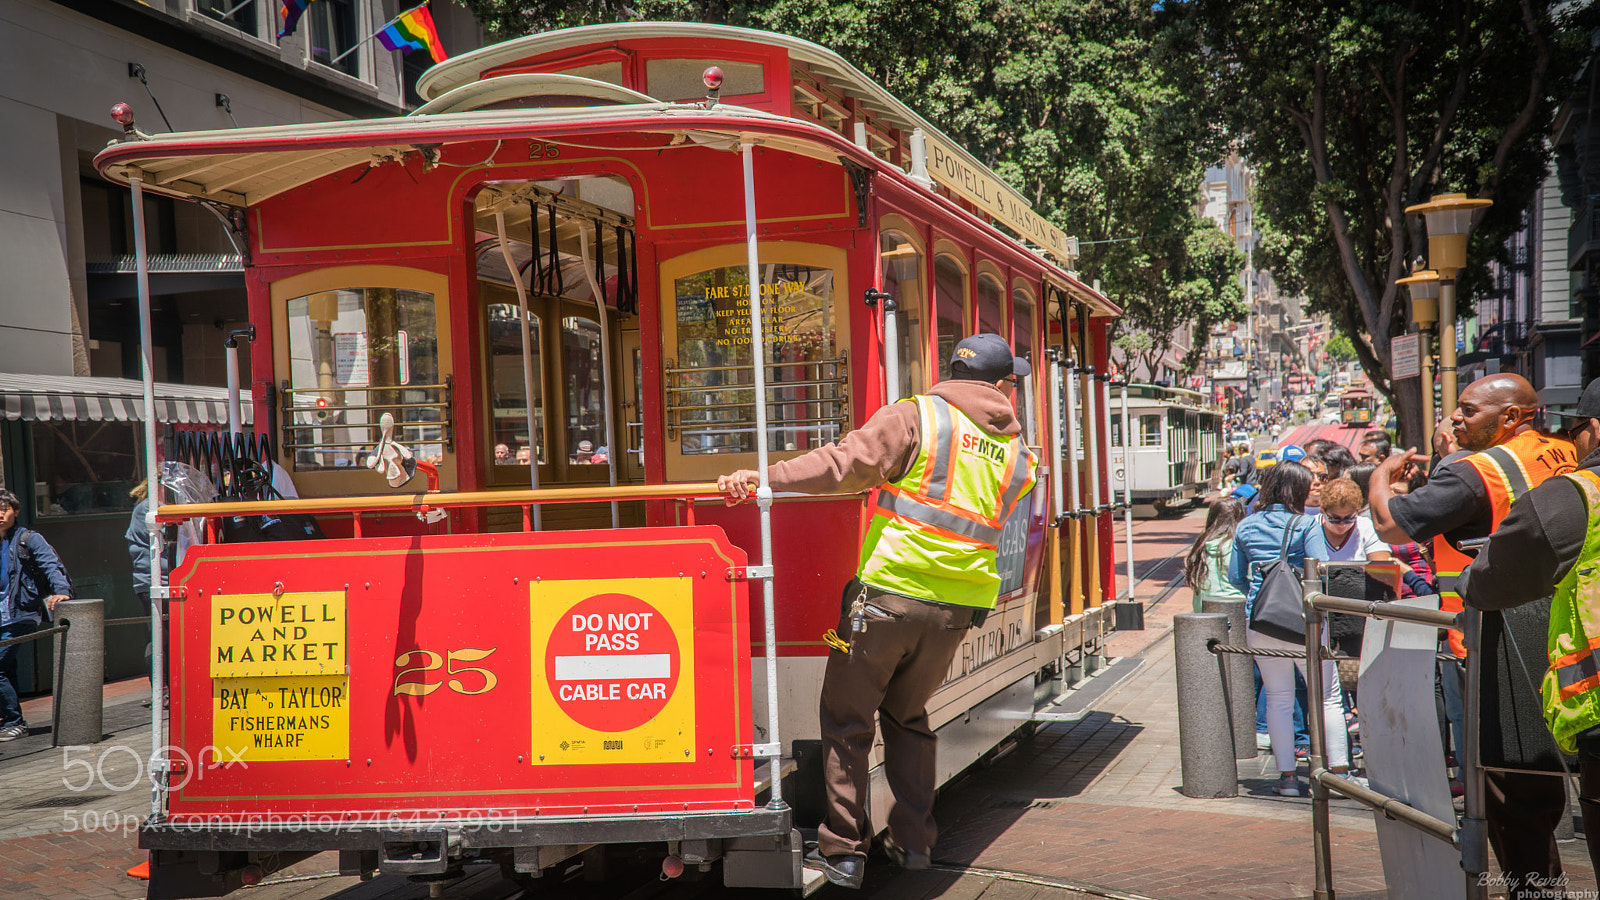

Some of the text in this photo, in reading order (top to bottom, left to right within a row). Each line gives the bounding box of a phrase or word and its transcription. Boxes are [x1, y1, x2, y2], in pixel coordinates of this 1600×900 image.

[529, 142, 560, 160] 25
[933, 145, 991, 204] POWELL
[996, 191, 1005, 214] &
[1009, 200, 1047, 241] MASON
[705, 281, 806, 299] FARE $7.0 ONE WAY
[736, 299, 752, 307] HO
[770, 306, 796, 314] FLOOR
[741, 325, 790, 335] TRSFERS
[733, 337, 753, 345] FOO
[962, 433, 1005, 463] SFMTA
[220, 604, 336, 626] POWELL
[572, 612, 653, 631] DO NOT
[250, 626, 307, 642] AND
[585, 633, 640, 651] PASS
[217, 642, 338, 663] MARKET
[393, 646, 498, 697] 25
[220, 688, 249, 710] BAY
[278, 686, 342, 709] TAYLOR
[559, 683, 666, 701] CABLE CAR
[230, 715, 330, 731] FISHERMANS
[254, 733, 305, 748] WHARF
